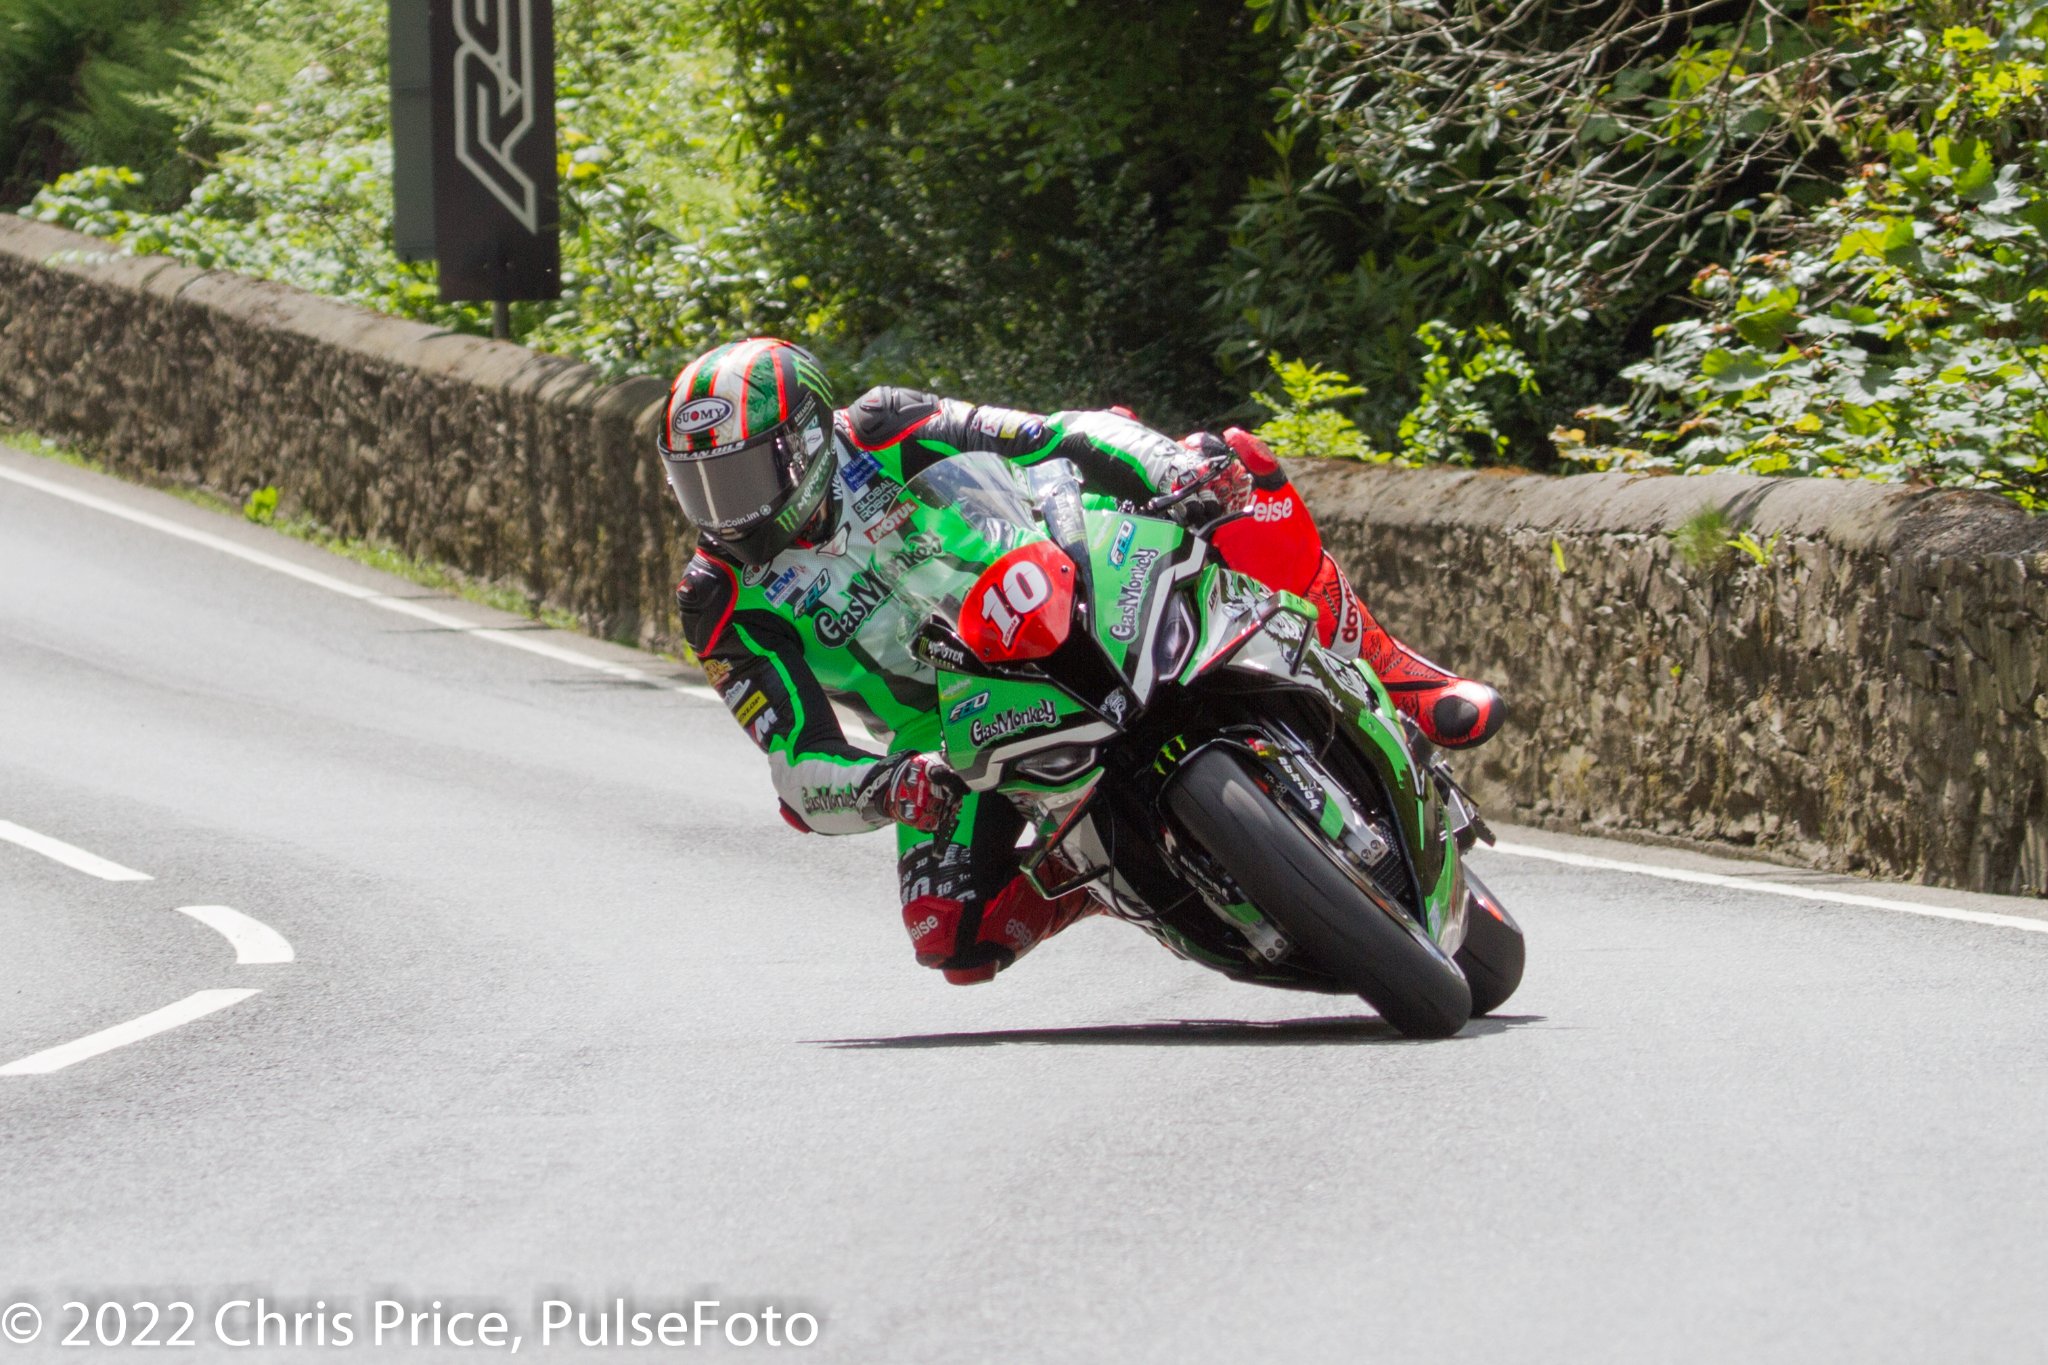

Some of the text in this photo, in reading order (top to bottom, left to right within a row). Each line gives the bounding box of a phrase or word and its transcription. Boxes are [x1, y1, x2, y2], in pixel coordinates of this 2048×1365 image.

[675, 406, 724, 425] SUOMY
[853, 478, 897, 514] GLOBAL
[861, 483, 902, 521] ROBOTS
[870, 501, 917, 543] MOTUL
[764, 565, 797, 601] LEW
[1109, 547, 1160, 643] GasMonkey
[981, 560, 1050, 649] 10
[970, 699, 1057, 747] GasMonkey
[908, 914, 938, 943] eise
